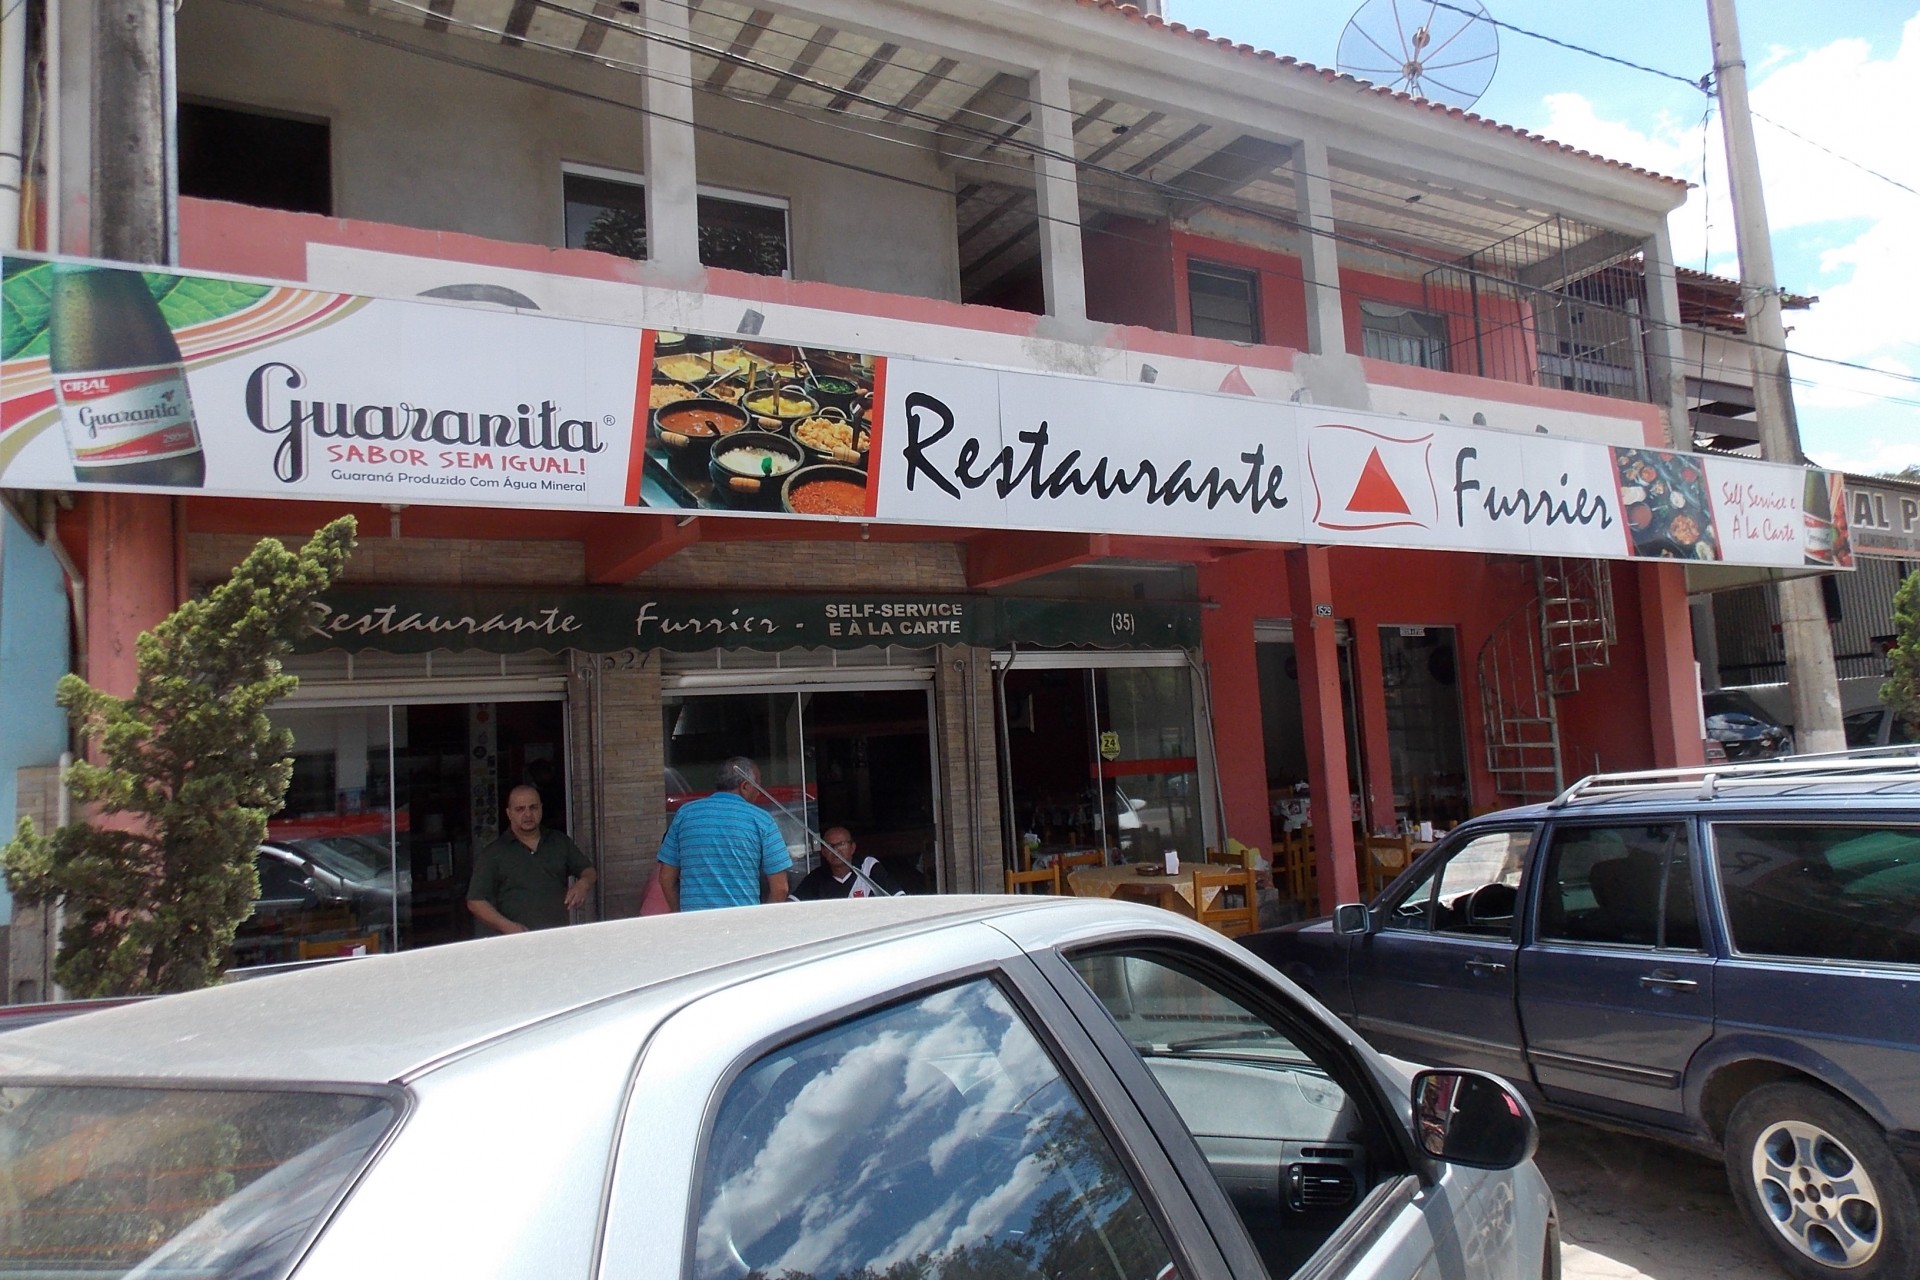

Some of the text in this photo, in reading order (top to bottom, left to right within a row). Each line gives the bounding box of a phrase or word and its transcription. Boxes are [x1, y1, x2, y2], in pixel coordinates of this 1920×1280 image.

[326, 444, 586, 476] SABOR SEM IGUAL!
[902, 391, 1288, 514] Restaurante
[331, 468, 586, 493] Guaraná Produzido Com Água Mineral
[1453, 446, 1613, 530] Furrier
[1721, 480, 1743, 516] Self
[1747, 482, 1786, 510] Service
[1845, 489, 1920, 534] AL P
[1762, 518, 1795, 542] Carte
[308, 601, 583, 640] Restaurante
[636, 602, 780, 636] Furrier
[825, 603, 963, 618] SELF-SERVICE
[1317, 605, 1331, 616] 1529
[829, 618, 961, 636] E À LA CARTE
[1111, 612, 1135, 635] (35)
[1104, 739, 1116, 748] 24
